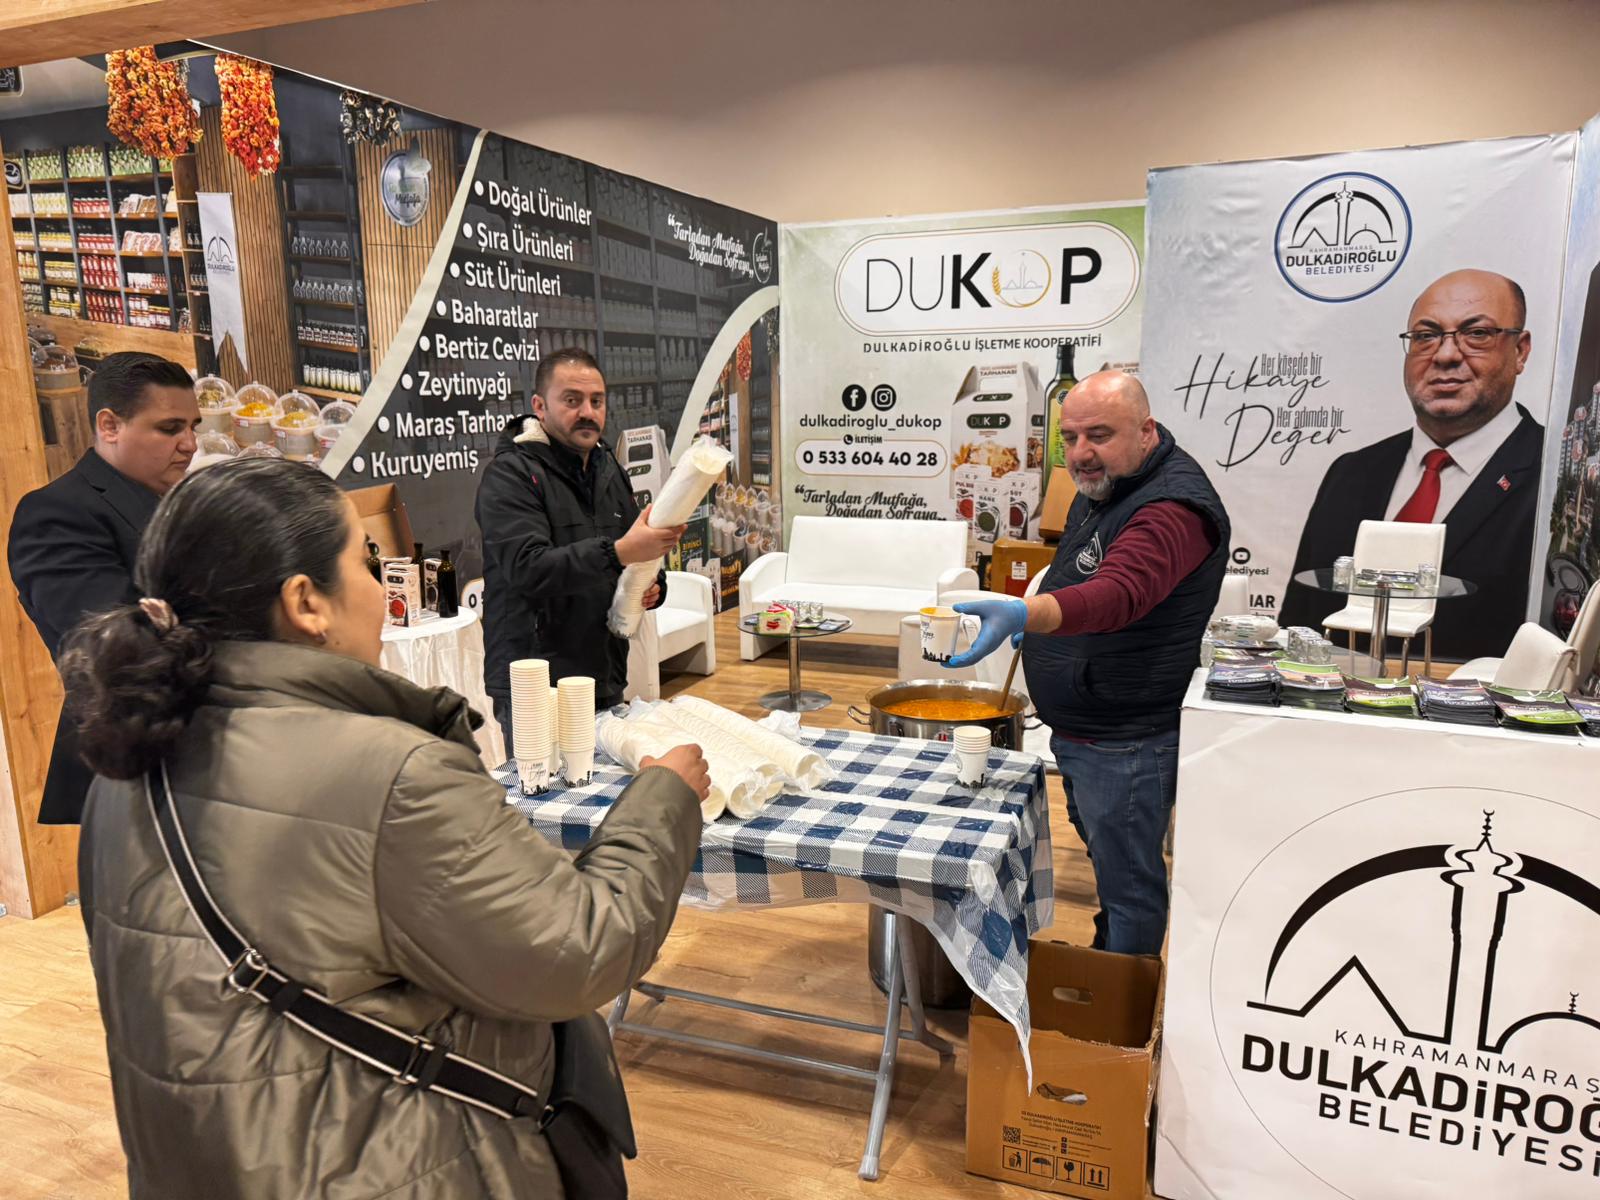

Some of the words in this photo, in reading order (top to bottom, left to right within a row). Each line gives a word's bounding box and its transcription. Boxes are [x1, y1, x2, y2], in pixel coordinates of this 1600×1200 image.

[488, 181, 535, 216] Doğal
[538, 187, 592, 225] Ürünler
[477, 222, 509, 252] Şıra
[512, 223, 573, 261] Ürünleri
[464, 261, 495, 289] Süt
[497, 260, 561, 296] Ürünleri
[451, 299, 538, 328] Baharatlar
[435, 334, 489, 360] Bertiz
[492, 336, 540, 361] Cevizi
[863, 338, 971, 353] DULKADİROĞLU
[975, 337, 1021, 352] İŞLETME
[1024, 334, 1101, 348] KOOPERATİFİ
[1261, 354, 1275, 376] Her
[1277, 353, 1308, 378] köşede
[1310, 352, 1323, 376] bir
[418, 371, 511, 401] Zeytinyağı
[1174, 352, 1330, 420] Hikaye
[396, 412, 455, 440] Maraş
[800, 414, 942, 430] dulkadiroglu_dukop
[1277, 407, 1292, 428] Her
[1331, 406, 1344, 428] bir
[1216, 402, 1352, 472] Değer
[371, 445, 479, 478] Kuruyemiş
[803, 450, 813, 464] 0
[819, 450, 846, 464] 533
[851, 451, 884, 465] 604
[889, 452, 911, 466] 40
[916, 452, 938, 466] 28
[1335, 1029, 1600, 1094] KAHRAMANMARAŞ
